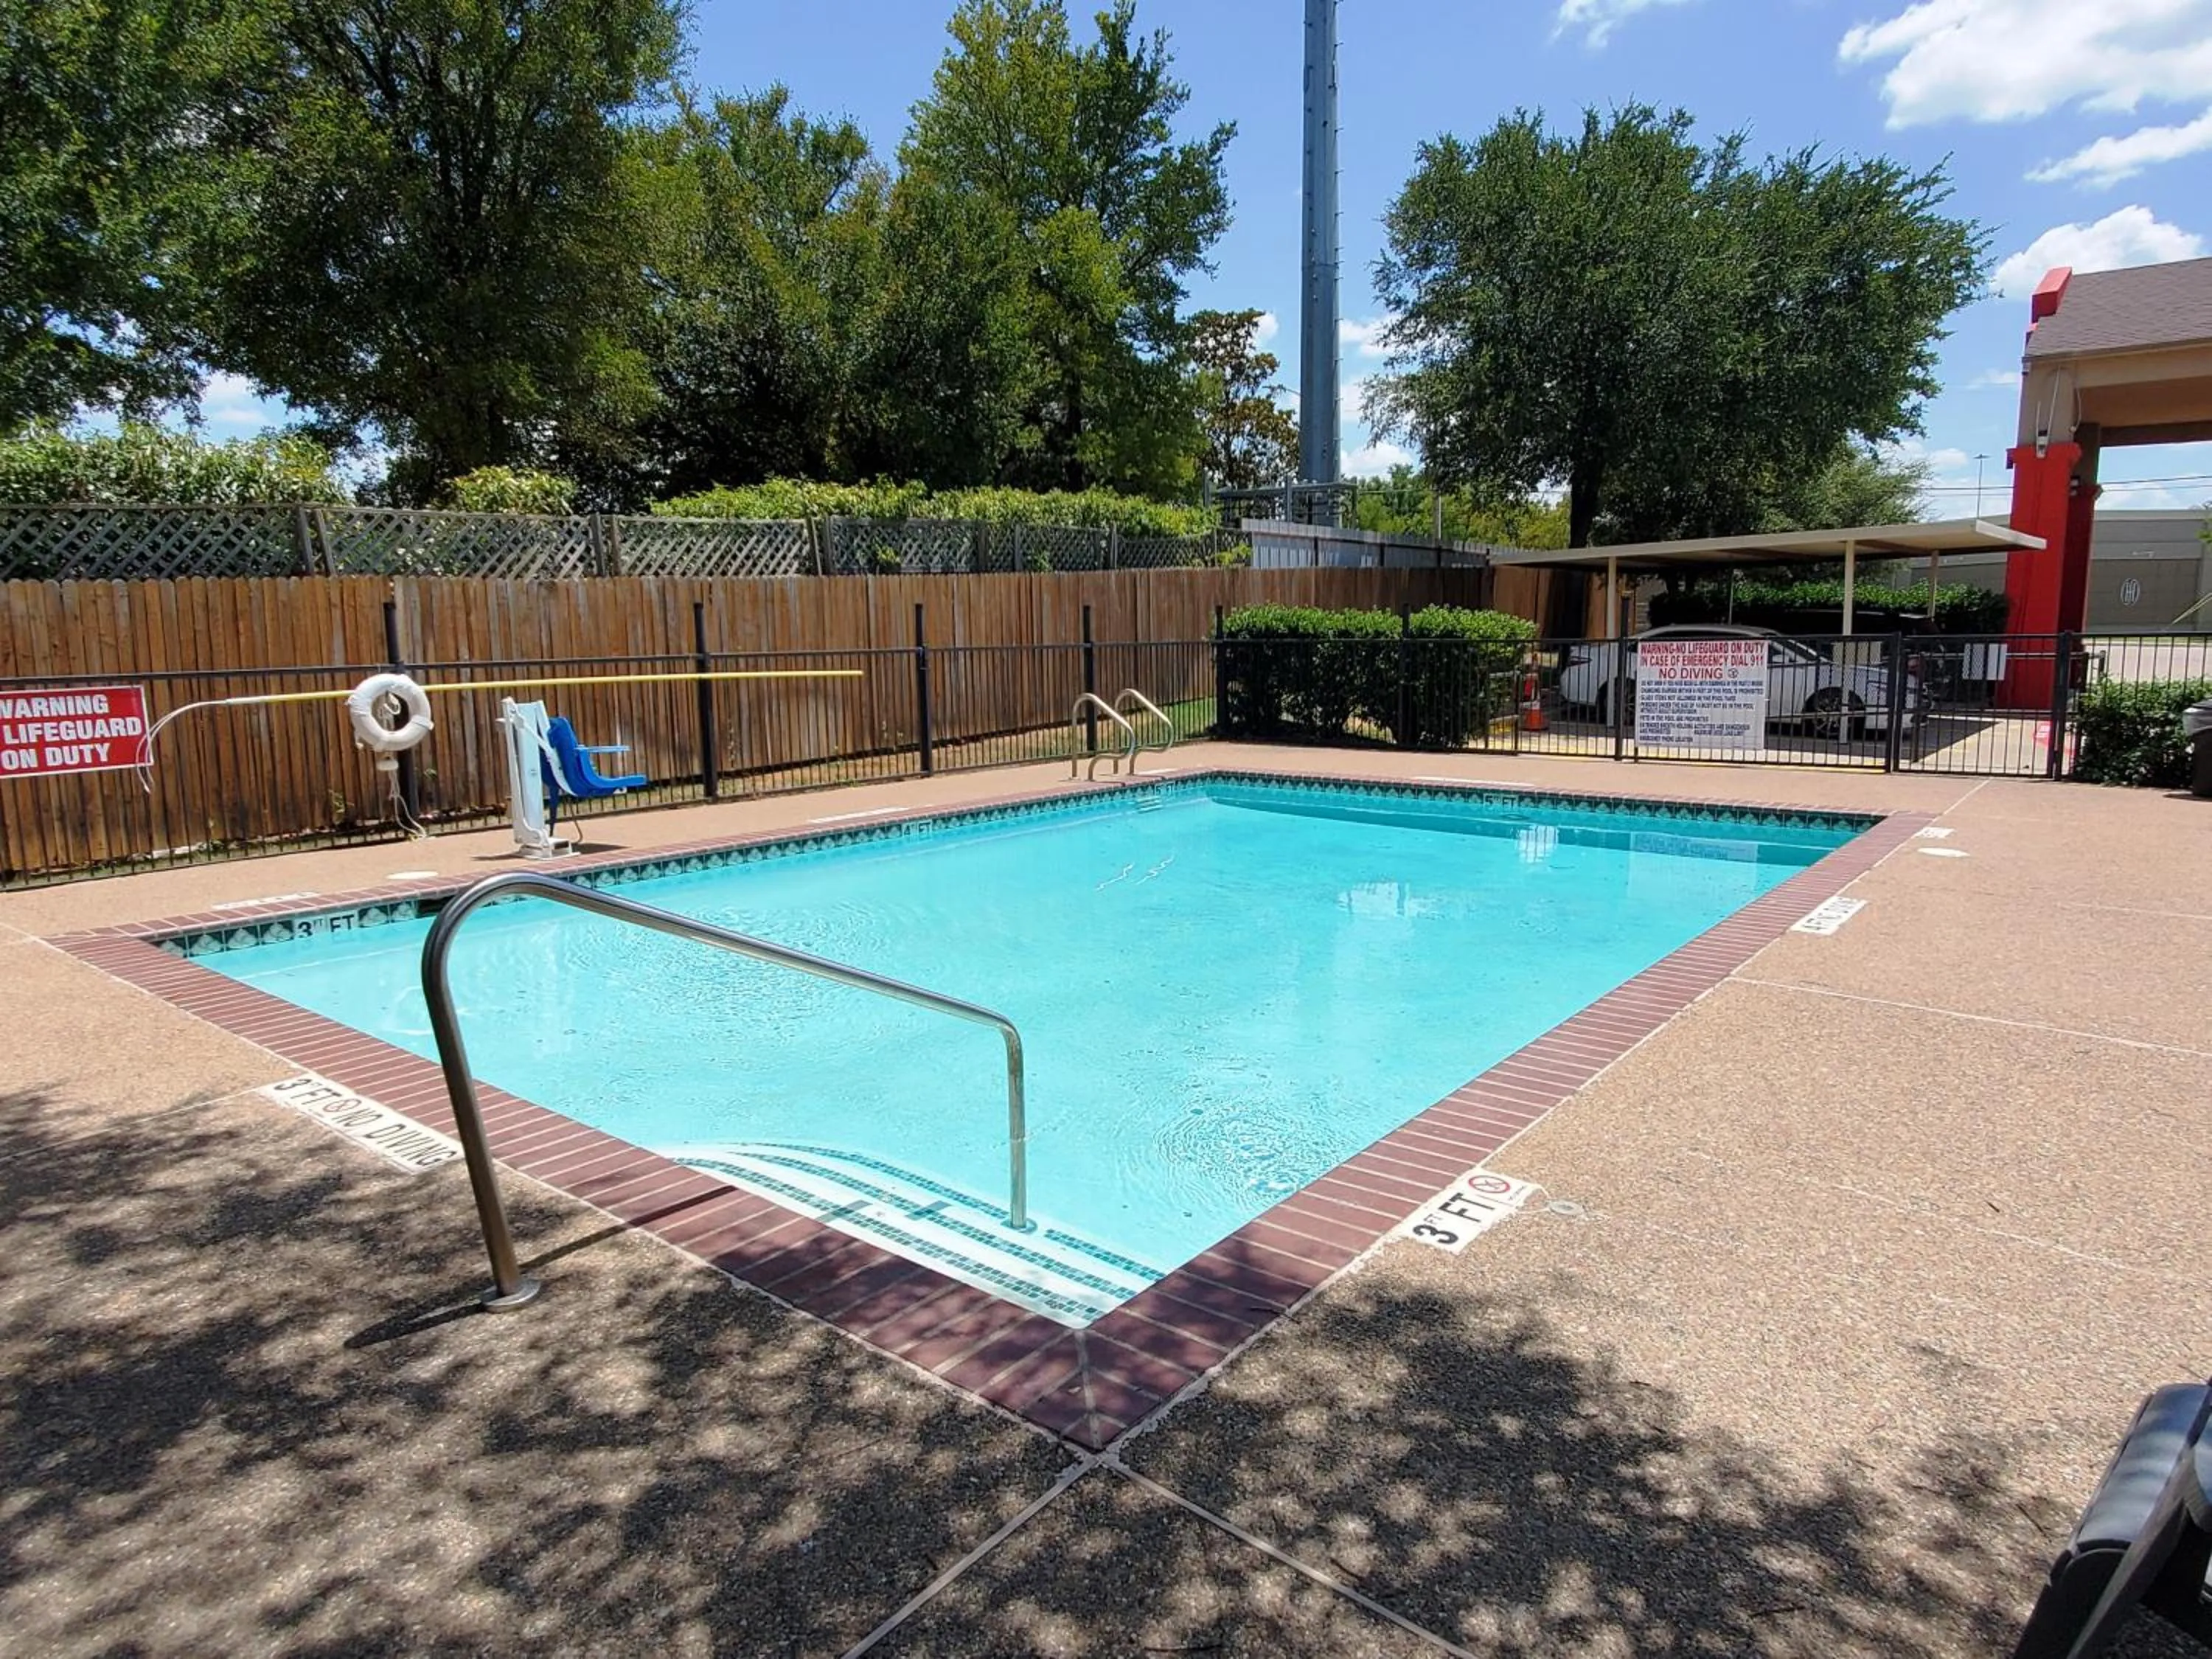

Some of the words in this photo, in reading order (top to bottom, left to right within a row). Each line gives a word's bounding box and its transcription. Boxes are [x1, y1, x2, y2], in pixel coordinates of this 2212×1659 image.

[1688, 642, 1728, 653] LIFEGUARD
[1731, 642, 1742, 653] ON
[1744, 642, 1764, 653] DUTY
[1640, 655, 1648, 667] IN
[1650, 655, 1669, 667] CASE
[1670, 655, 1680, 667] OF
[1682, 655, 1728, 667] EMERGENCY
[1731, 654, 1747, 667] DIAL
[1750, 655, 1764, 667] 911
[1658, 667, 1677, 679] NO
[1680, 667, 1723, 680] DIVING
[3, 716, 142, 745] LIFEGUARD
[1, 748, 38, 770] ON
[45, 742, 111, 767] DUTY
[329, 914, 355, 933] FT
[274, 1078, 311, 1091] 3
[291, 1088, 343, 1106] FT
[331, 1108, 384, 1128] NO
[364, 1122, 459, 1167] DIVING
[1413, 1224, 1459, 1245] 3
[1438, 1192, 1496, 1223] FT
